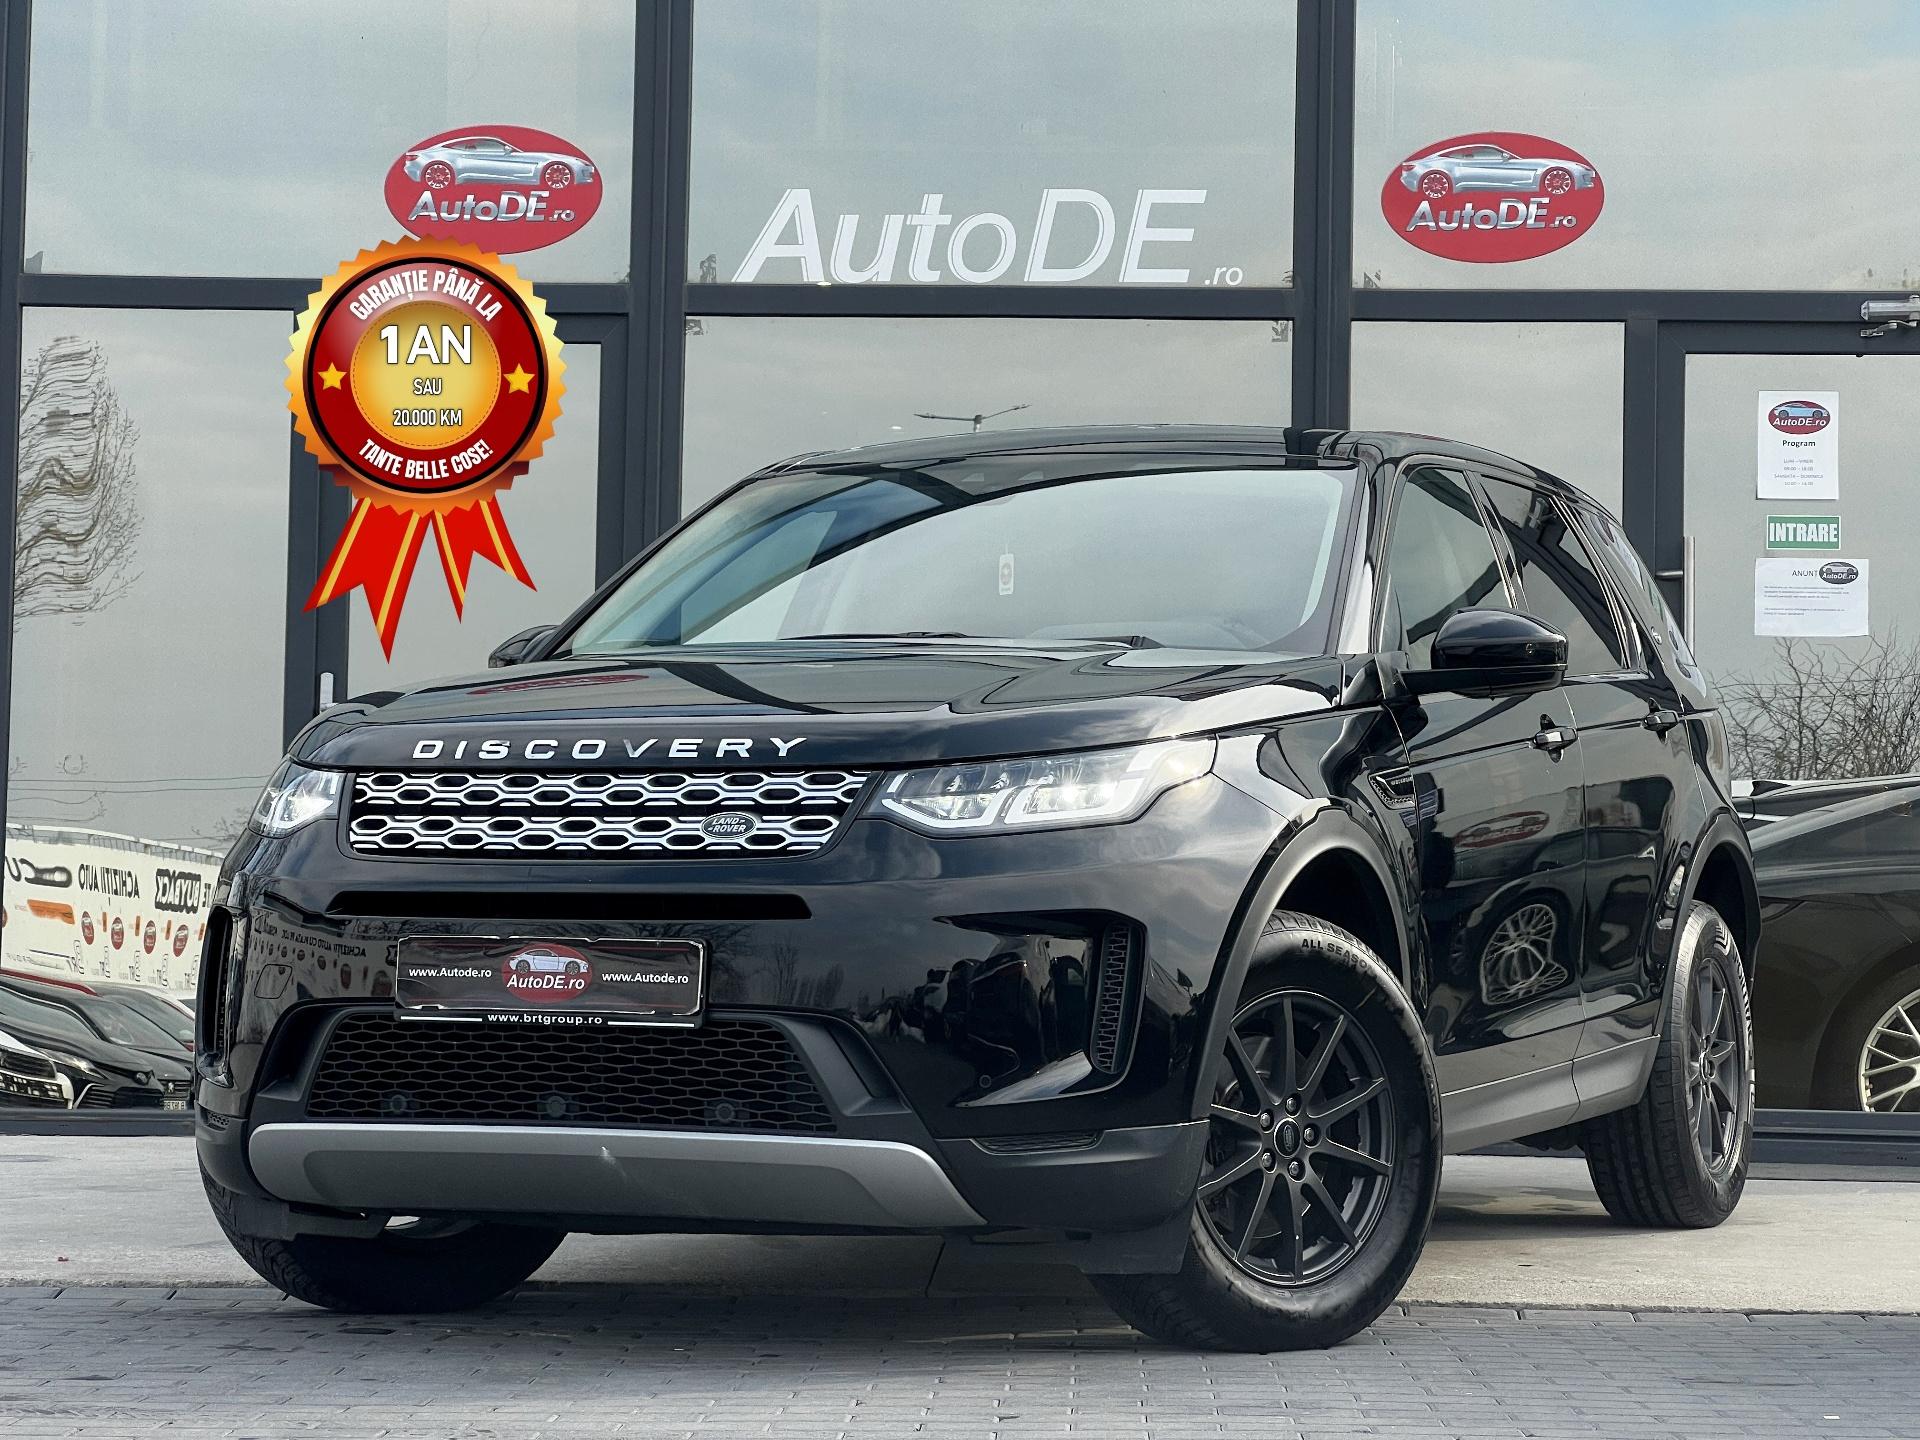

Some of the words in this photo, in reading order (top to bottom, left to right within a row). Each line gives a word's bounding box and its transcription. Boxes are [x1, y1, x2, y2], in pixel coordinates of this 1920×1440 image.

[408, 189, 576, 223] AutoDE.ro
[1404, 197, 1578, 232] AutoDE.ro
[1772, 416, 1828, 427] AutoDE.ro
[1782, 440, 1816, 449] Program
[1769, 522, 1839, 542] INTRARE
[412, 737, 807, 760] DISCOVERY
[712, 817, 740, 825] LAND
[712, 824, 746, 832] ROVER
[1302, 939, 1324, 950] ALL
[409, 966, 492, 979] www.Autode.ro
[507, 973, 586, 990] AutoDE.ro
[602, 971, 689, 984] www.Autode.ro
[487, 1012, 603, 1026] www.brtgroup.ro
